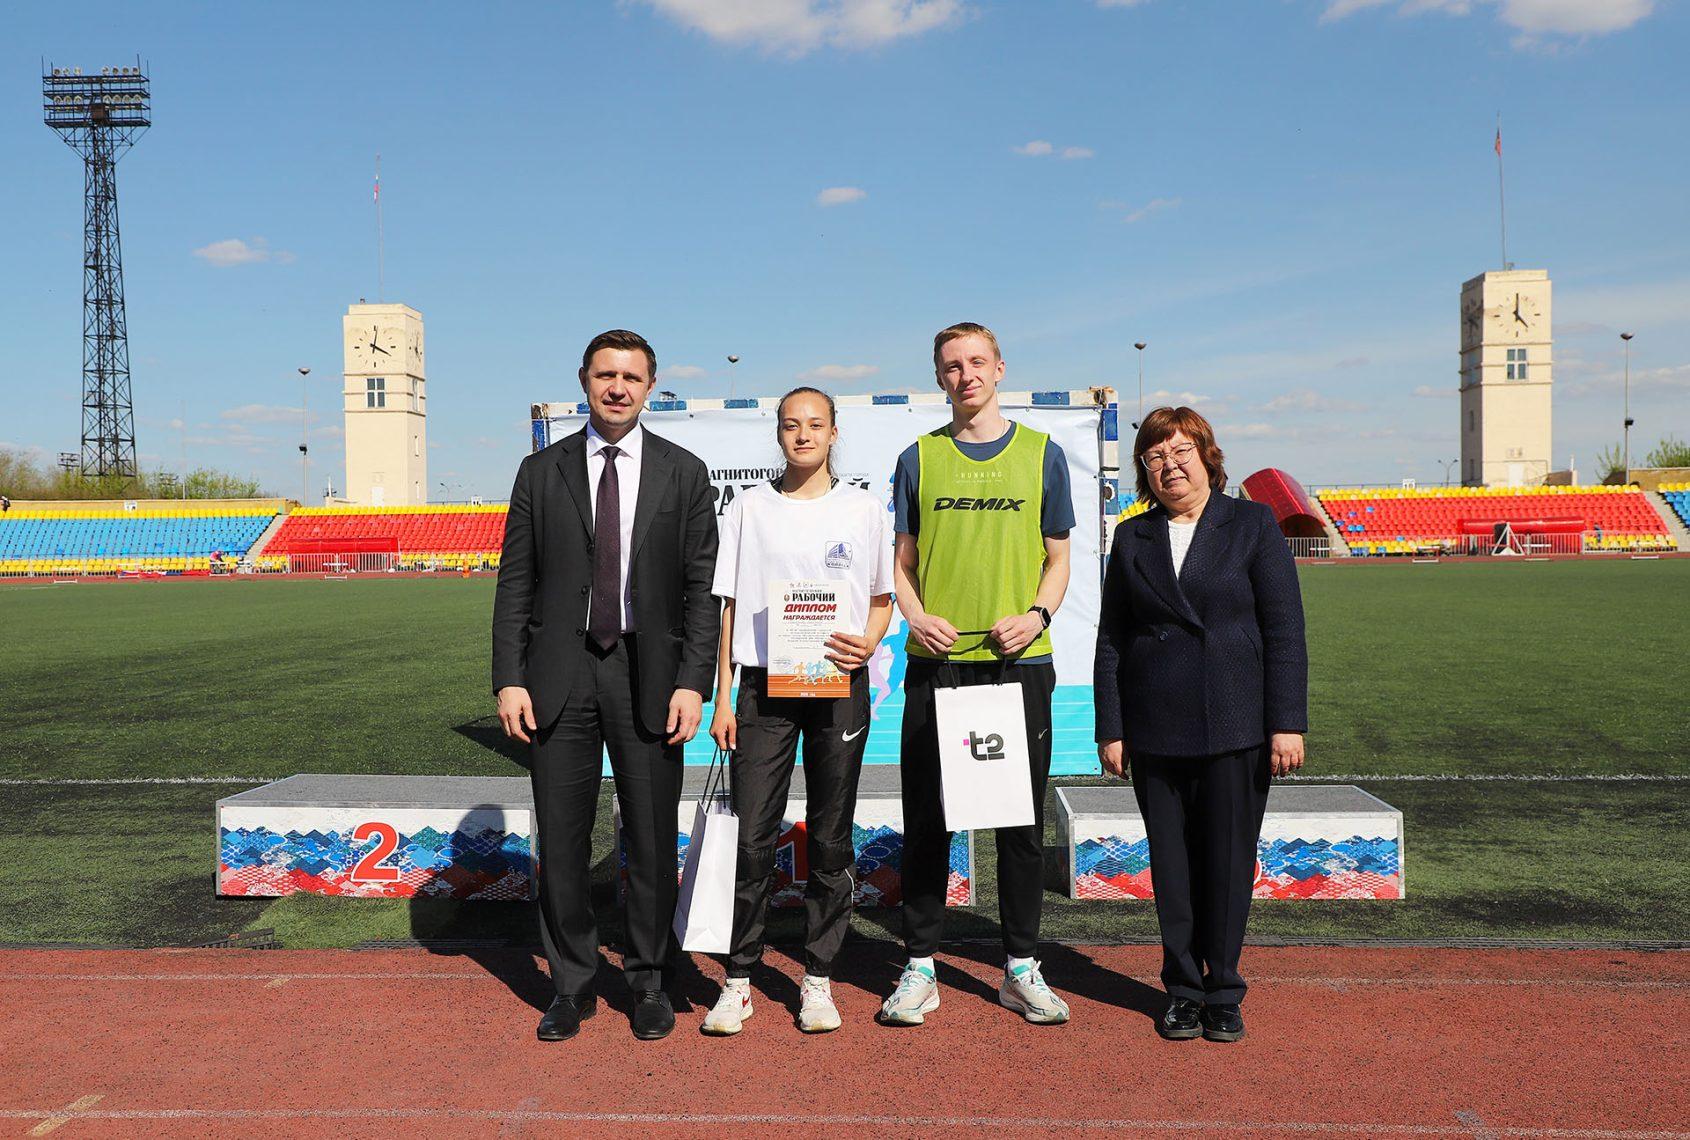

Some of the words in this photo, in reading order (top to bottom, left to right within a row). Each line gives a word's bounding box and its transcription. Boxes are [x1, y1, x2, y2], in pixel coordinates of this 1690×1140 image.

[934, 497, 1026, 511] DEMIX
[783, 603, 837, 613] ДИПЛОМ
[351, 822, 400, 881] 2
